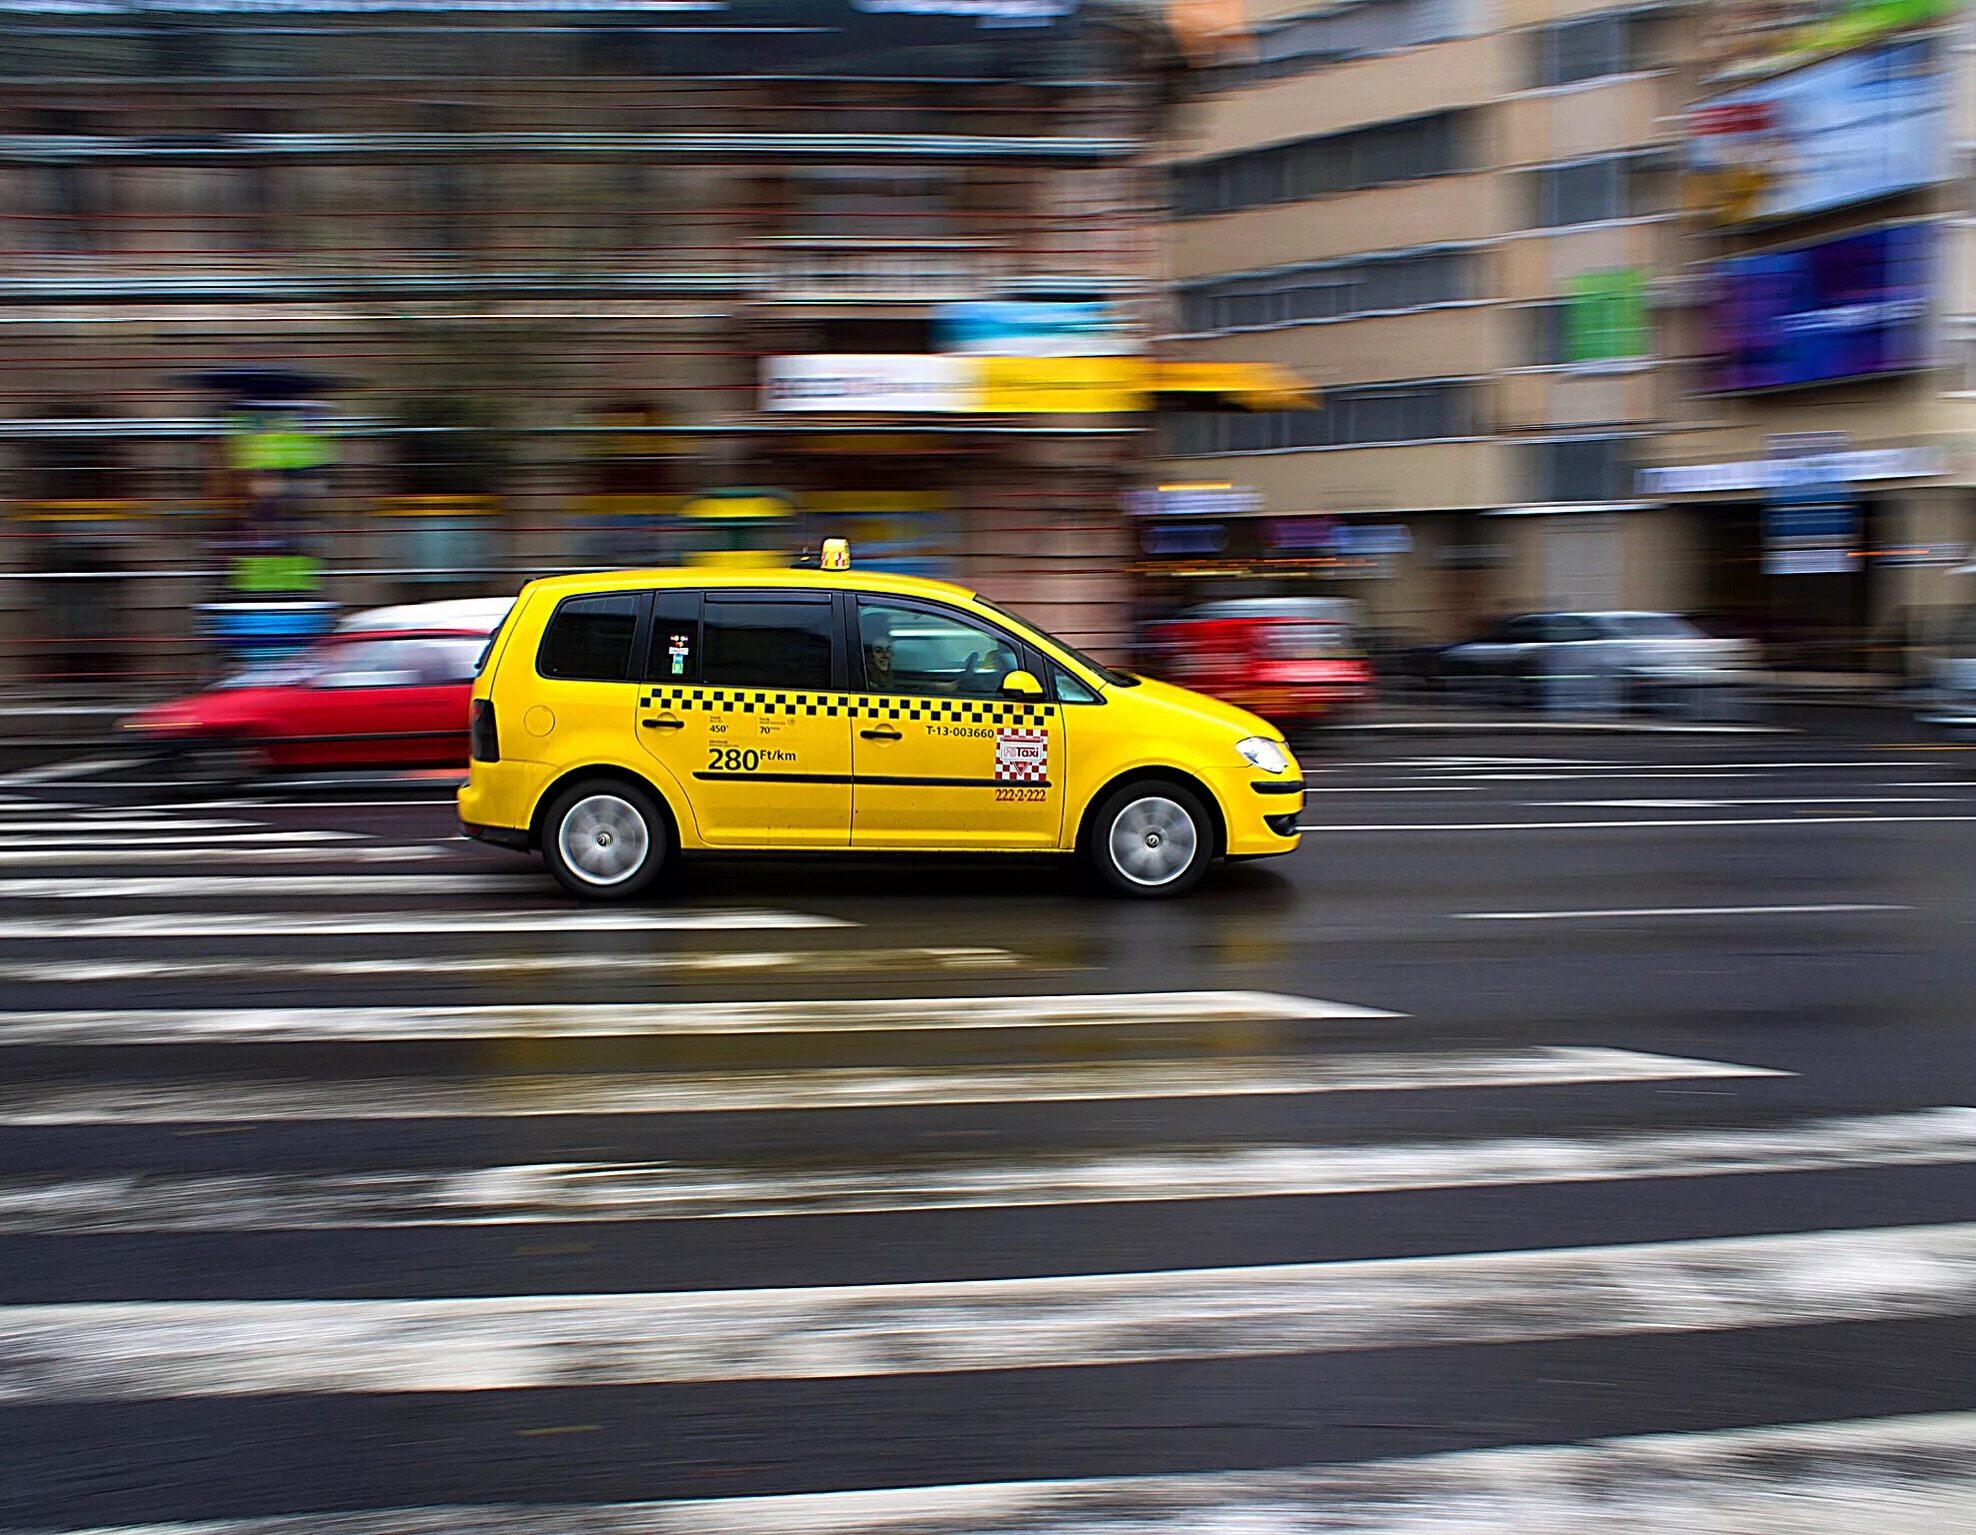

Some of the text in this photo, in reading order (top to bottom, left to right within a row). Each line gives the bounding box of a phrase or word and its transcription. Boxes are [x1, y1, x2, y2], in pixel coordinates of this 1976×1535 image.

[926, 725, 995, 738] T-13-003660
[708, 748, 797, 771] 280 Ft/km
